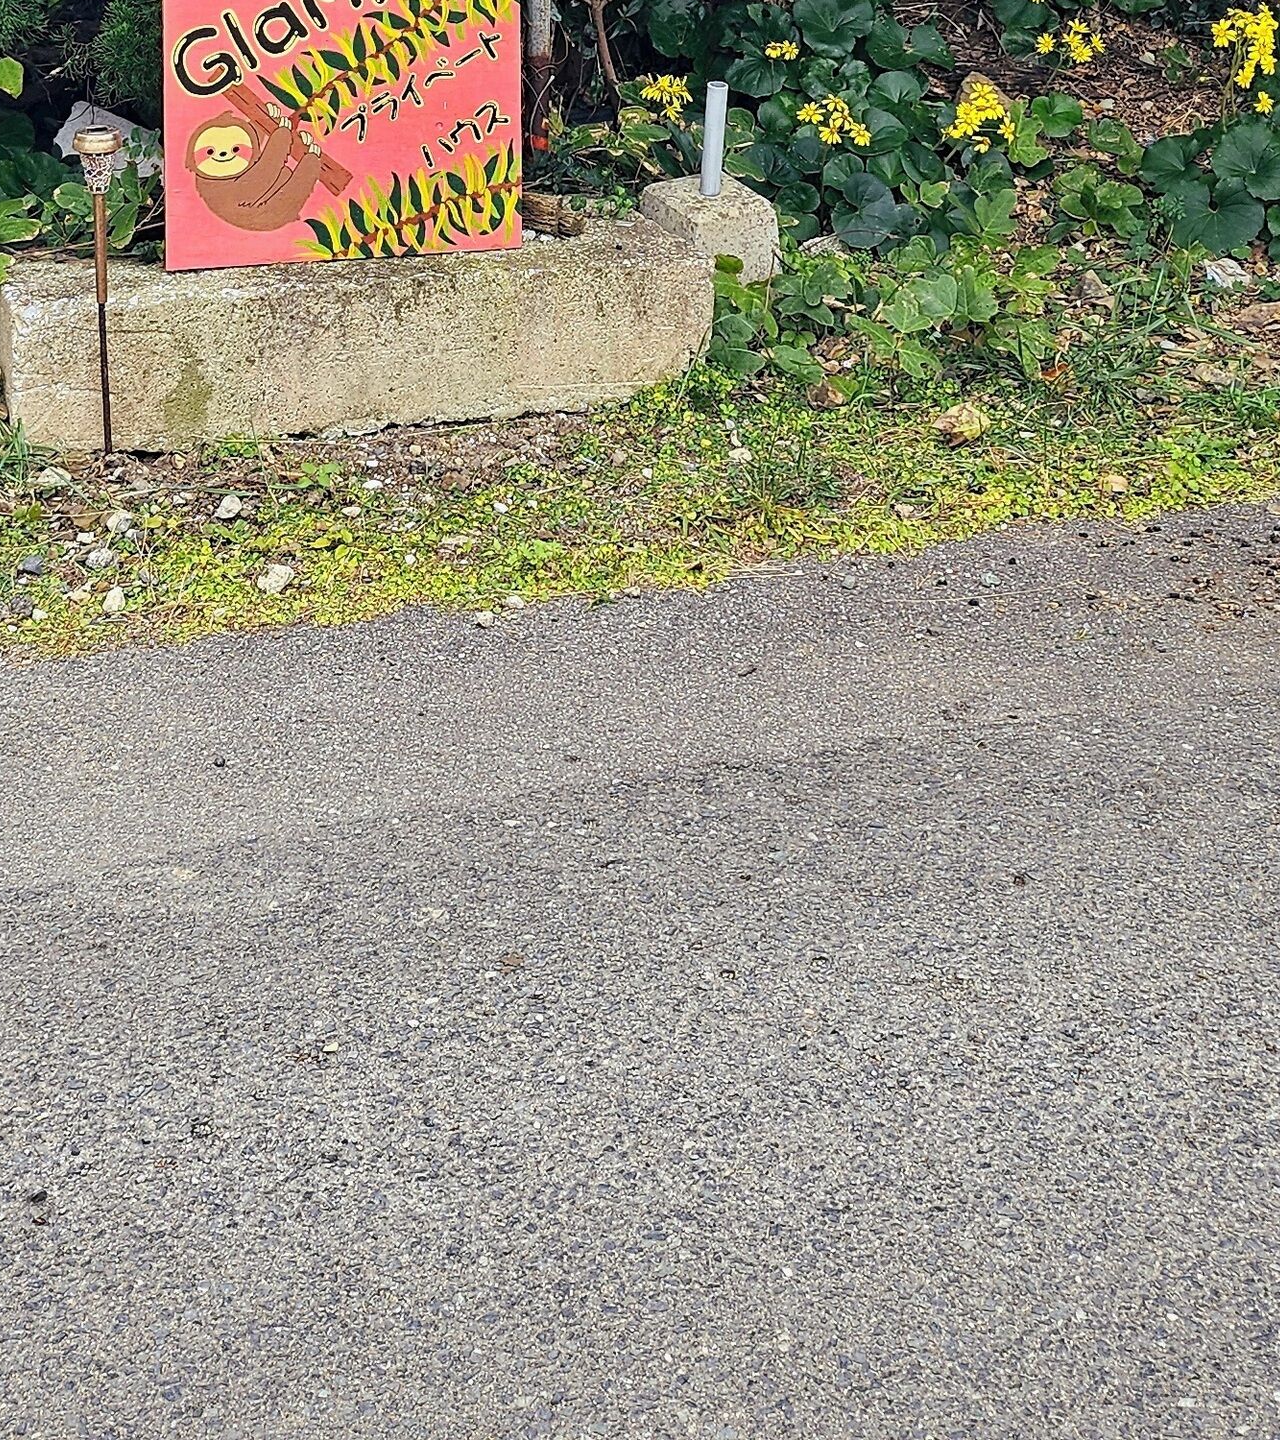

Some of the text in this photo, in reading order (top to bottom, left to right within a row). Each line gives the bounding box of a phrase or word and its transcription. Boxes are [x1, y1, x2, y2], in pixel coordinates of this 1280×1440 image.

[341, 32, 501, 142] プライベート
[422, 101, 509, 167] ハウス
